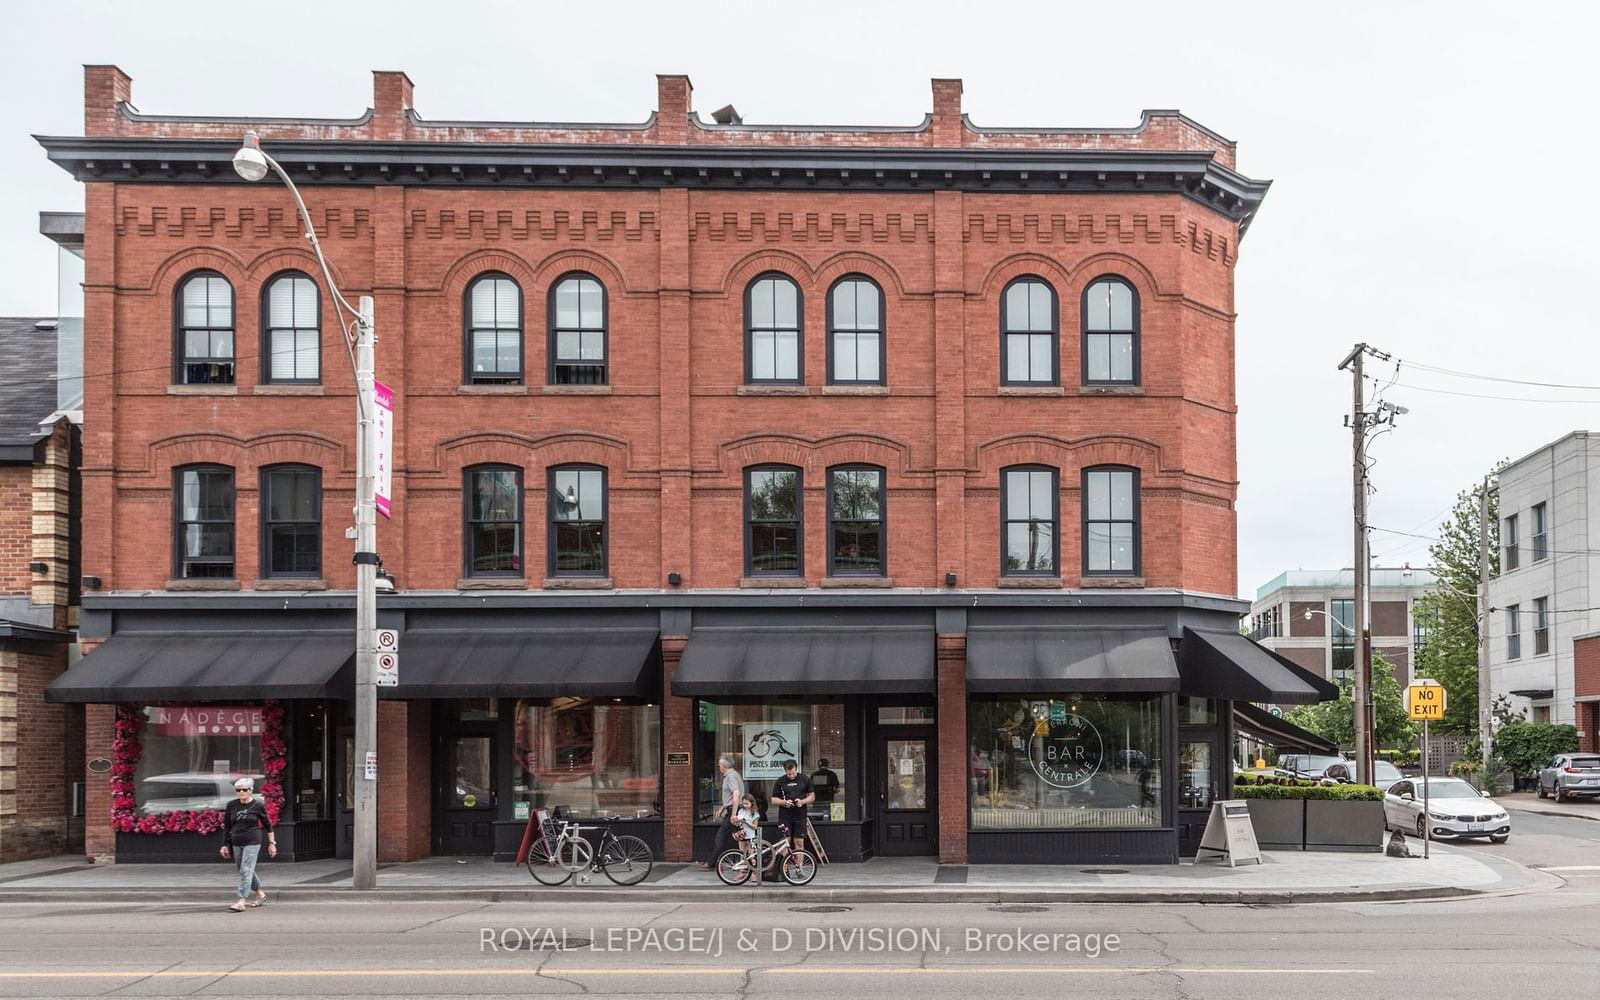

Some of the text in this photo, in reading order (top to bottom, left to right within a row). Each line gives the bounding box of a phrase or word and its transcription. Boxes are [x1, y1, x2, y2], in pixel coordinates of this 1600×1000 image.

[1419, 690, 1434, 700] NO
[1414, 705, 1438, 714] EXIT
[1047, 745, 1085, 760] BAR
[1038, 760, 1093, 782] CENTRALE
